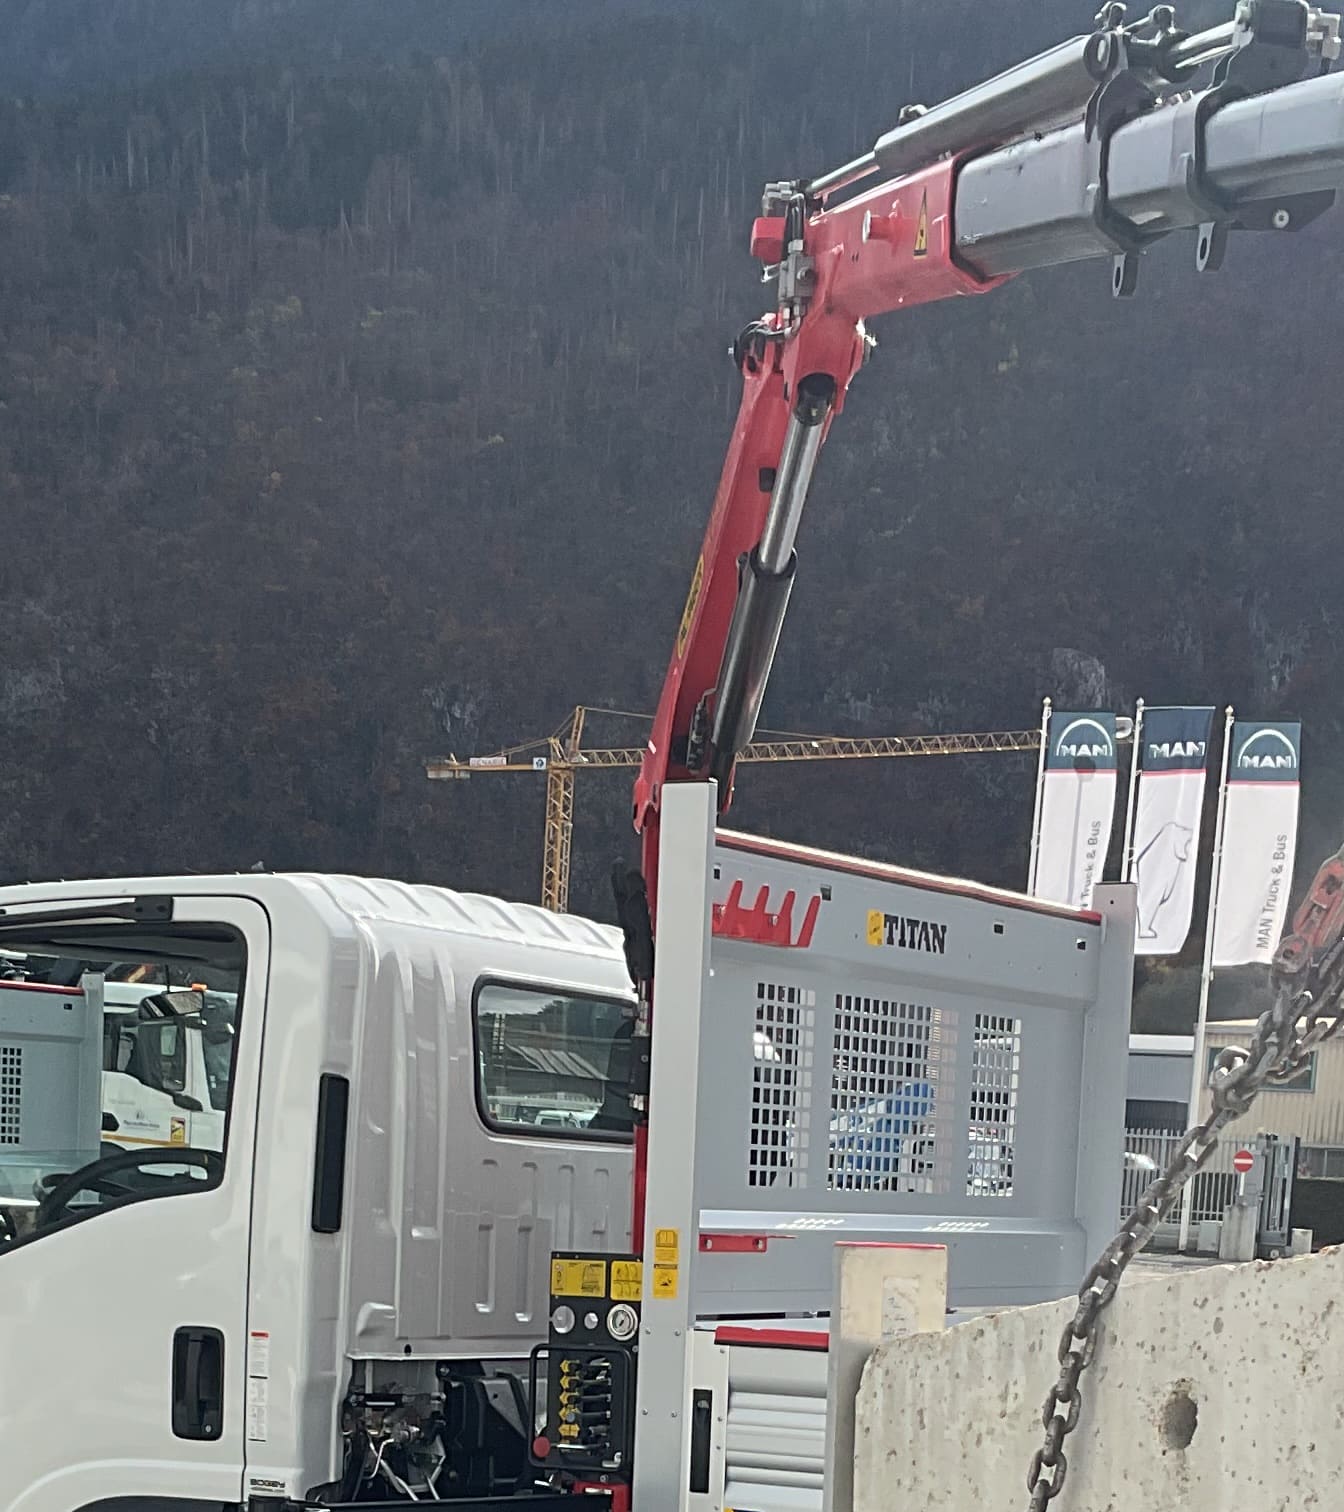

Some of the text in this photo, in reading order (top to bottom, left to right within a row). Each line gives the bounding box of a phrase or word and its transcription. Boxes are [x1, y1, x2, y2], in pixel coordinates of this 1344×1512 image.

[1061, 744, 1108, 757] MAN
[1149, 742, 1205, 758] MAN
[1243, 755, 1291, 768] MAN
[1080, 864, 1093, 901] Truck
[1088, 821, 1101, 845] Bus
[1256, 834, 1287, 949] MAN Truck & Bus
[884, 913, 947, 954] TITAN
